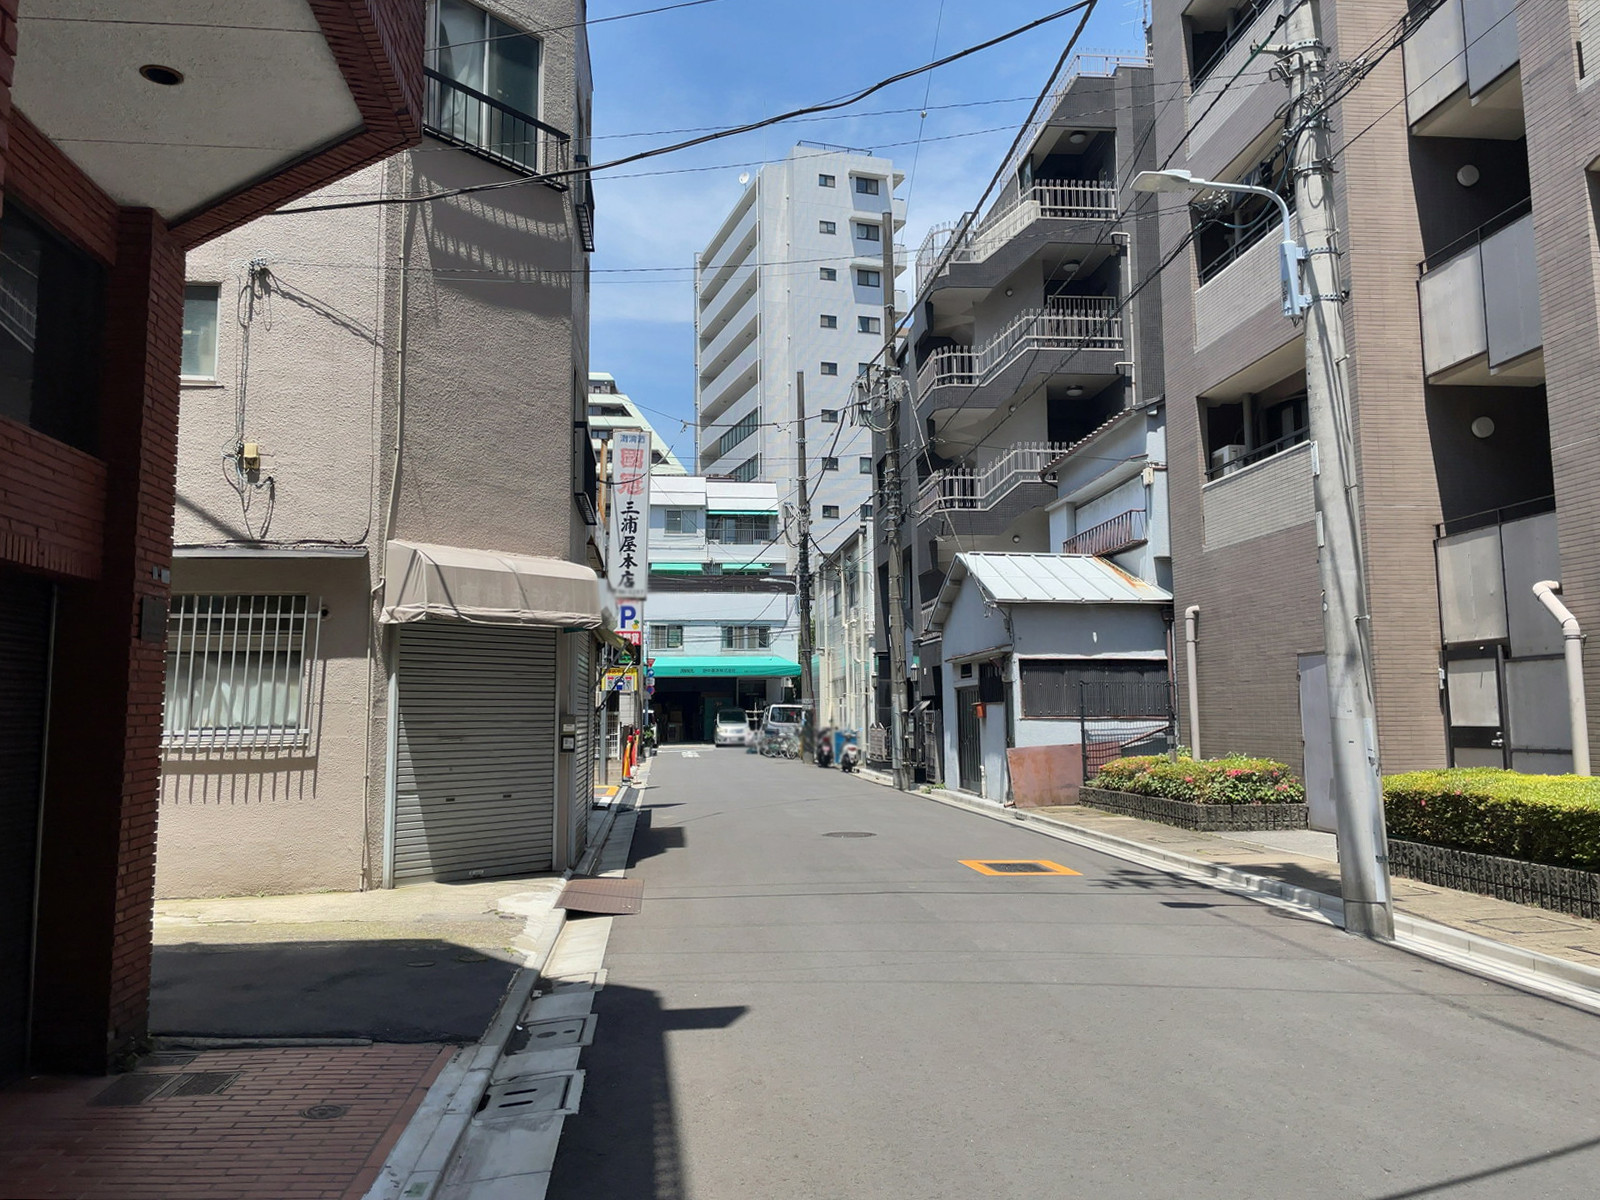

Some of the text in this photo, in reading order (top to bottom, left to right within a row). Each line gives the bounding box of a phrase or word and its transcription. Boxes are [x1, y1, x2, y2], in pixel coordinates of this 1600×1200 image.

[619, 501, 640, 589] 三浦屋本店
[620, 605, 636, 629] P
